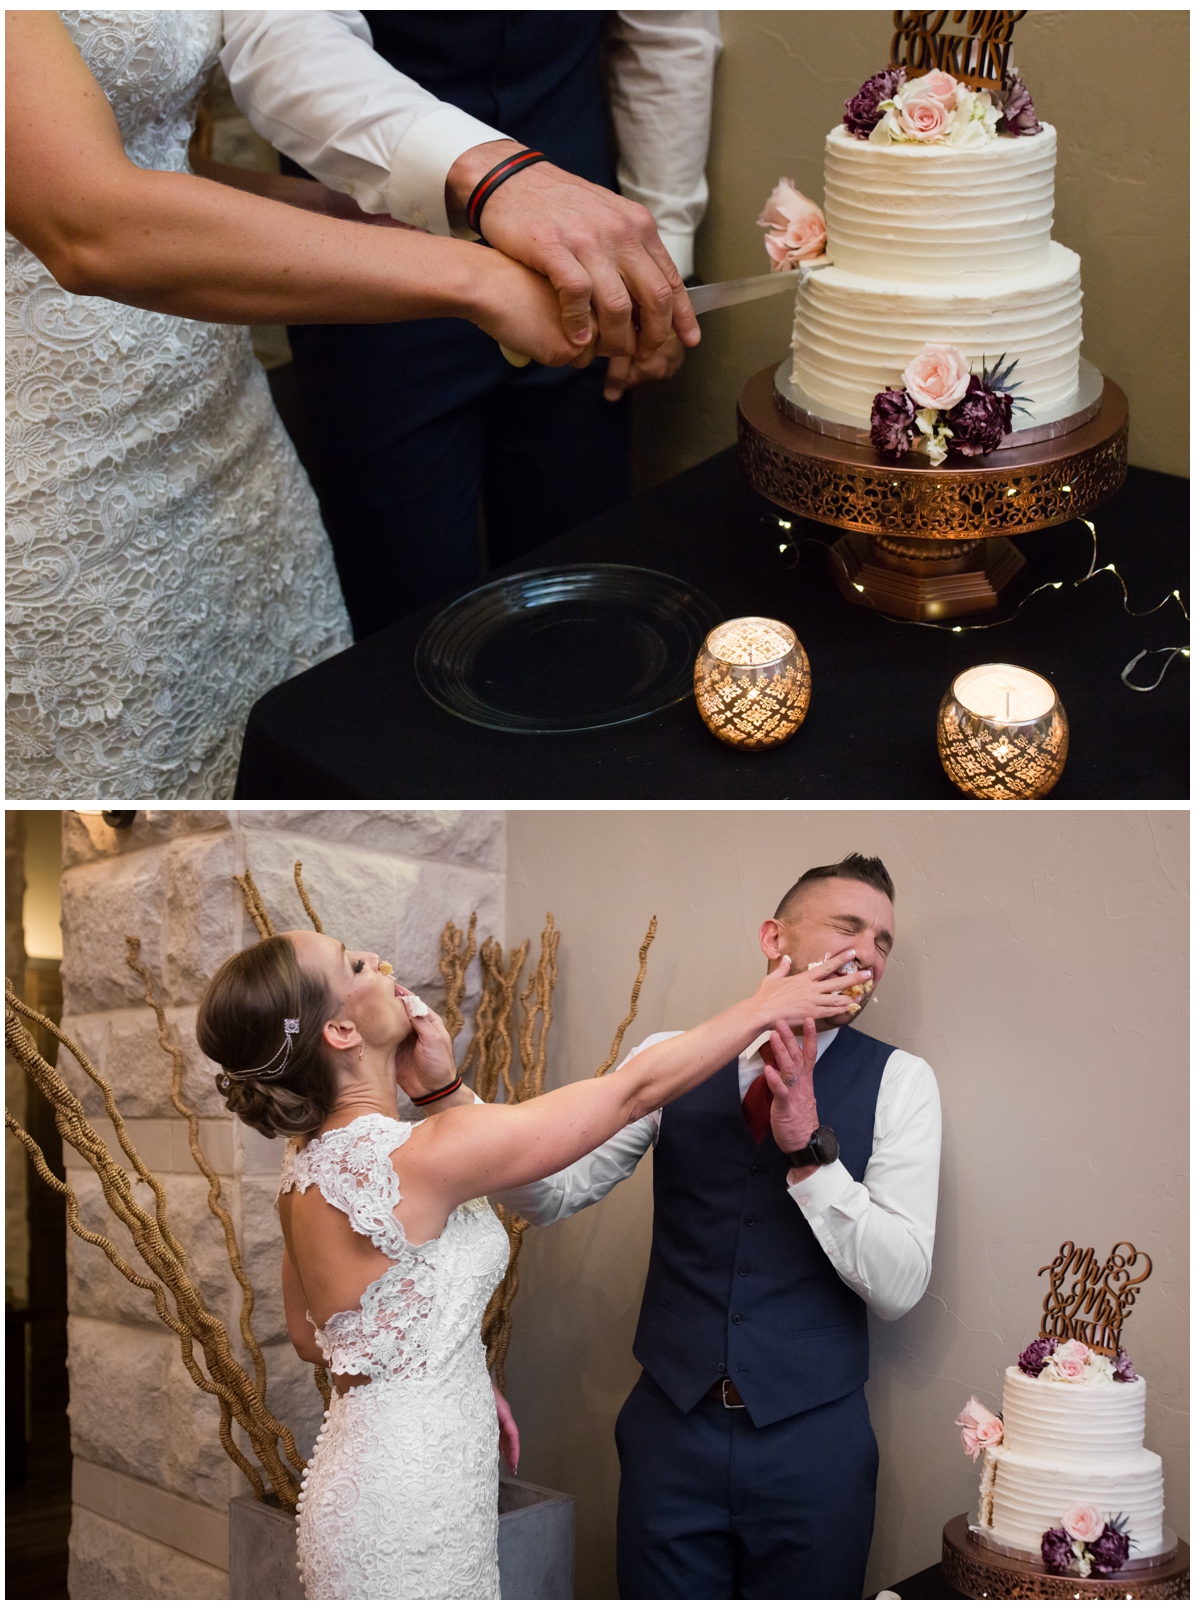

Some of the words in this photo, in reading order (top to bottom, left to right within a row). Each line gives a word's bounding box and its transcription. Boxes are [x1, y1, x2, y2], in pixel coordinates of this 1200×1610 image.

[890, 31, 1013, 80] CONKLIN
[1037, 1241, 1104, 1285] Mr
[1065, 1278, 1132, 1330] Mrs
[1040, 1313, 1122, 1351] CONKLIN
